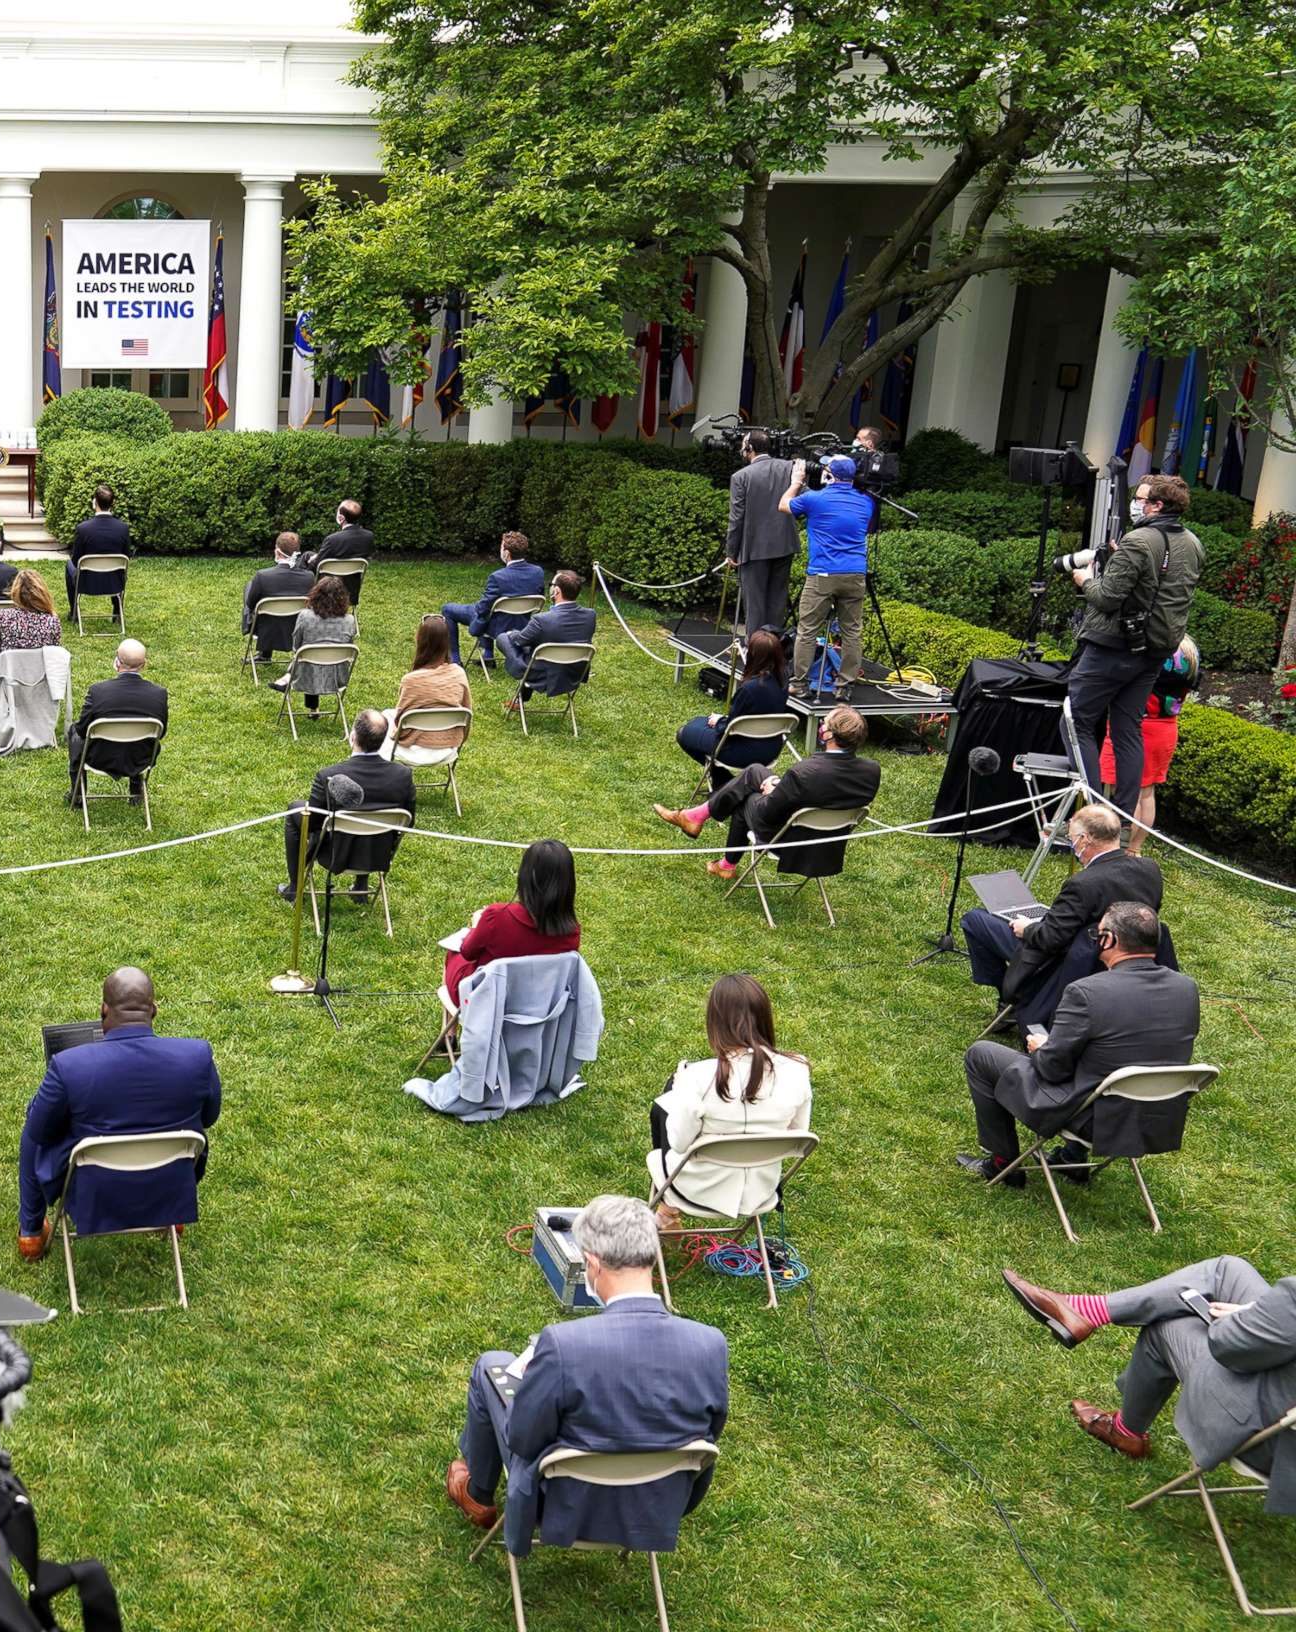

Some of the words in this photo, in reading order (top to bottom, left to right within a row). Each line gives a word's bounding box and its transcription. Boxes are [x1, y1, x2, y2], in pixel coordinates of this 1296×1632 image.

[76, 252, 195, 275] AMERICA
[77, 282, 117, 293] LEADS
[120, 282, 145, 293] THE
[148, 282, 195, 293] WORLD
[76, 300, 98, 319] IN
[103, 300, 194, 319] TESTING
